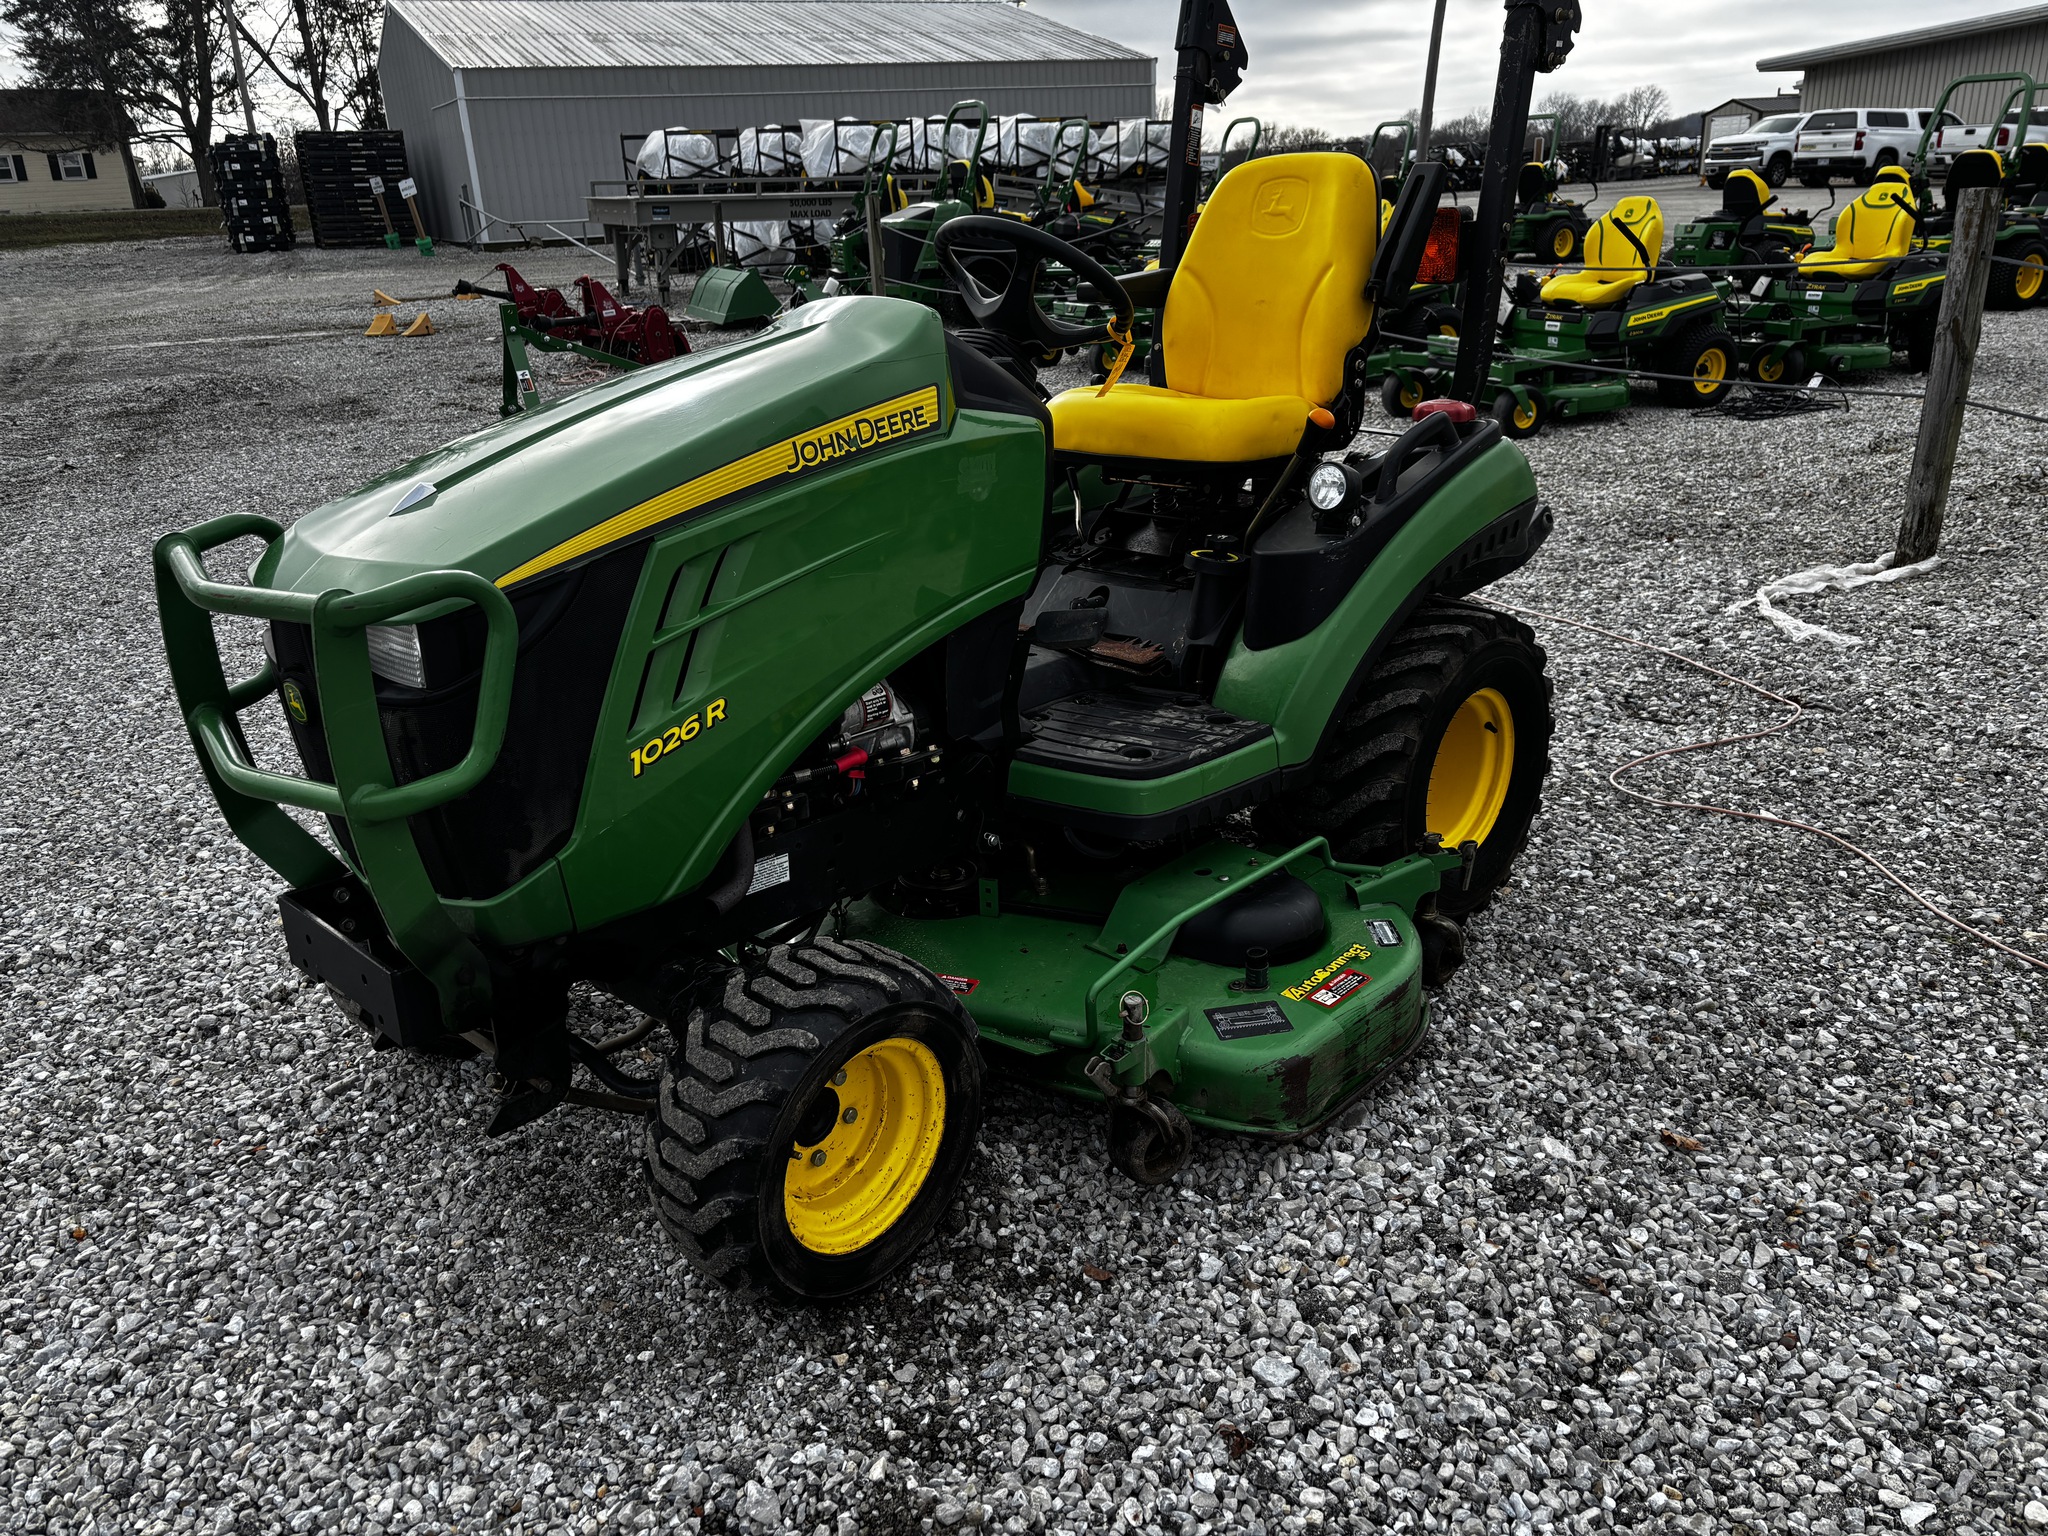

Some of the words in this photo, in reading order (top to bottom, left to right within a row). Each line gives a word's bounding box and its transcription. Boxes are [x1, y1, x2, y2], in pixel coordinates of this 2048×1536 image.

[818, 198, 833, 206] LBS
[790, 209, 809, 218] MAX
[811, 209, 832, 218] LOAD
[1646, 311, 1663, 319] DEERE
[787, 427, 857, 472] JOHN
[854, 405, 929, 447] DEERE
[630, 712, 703, 778] 1026
[706, 697, 729, 729] R
